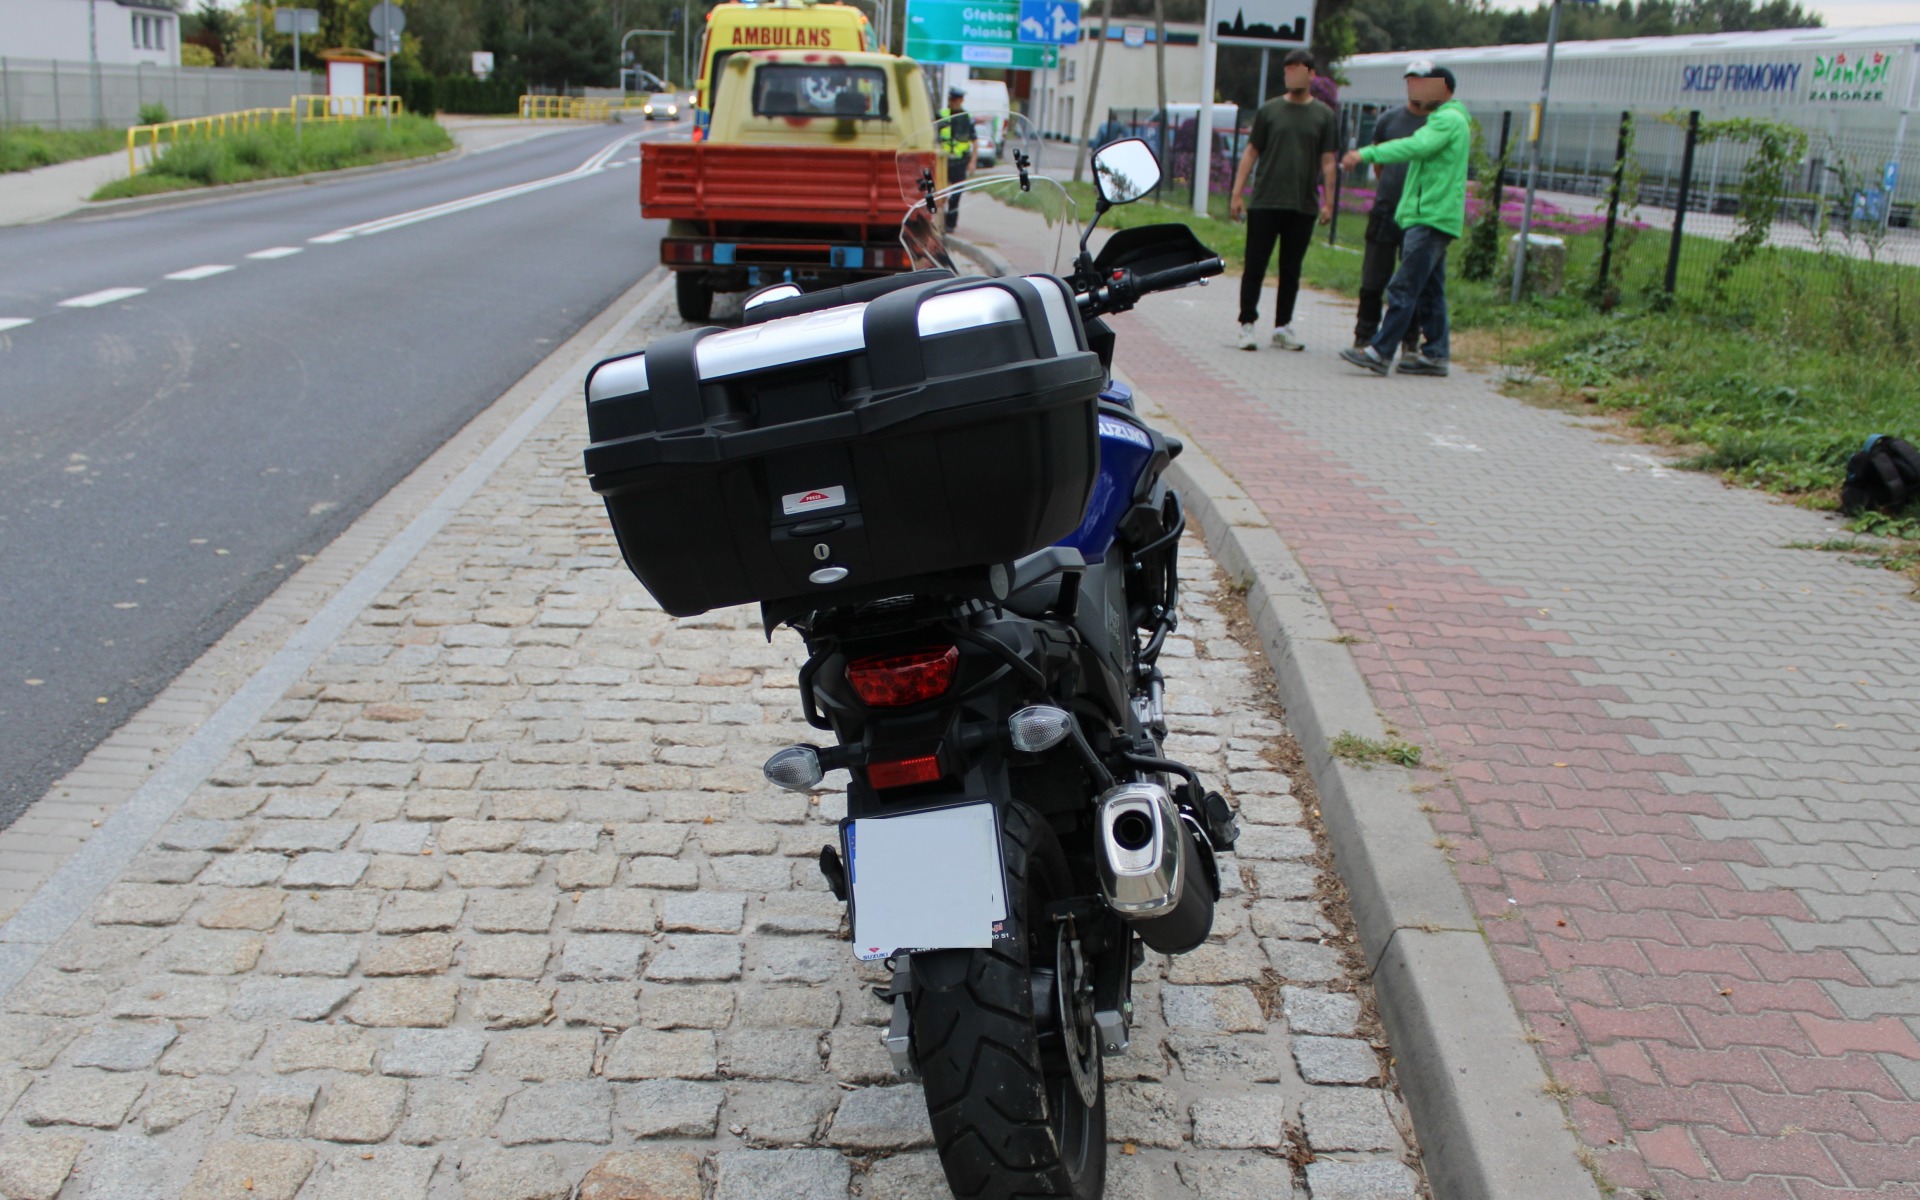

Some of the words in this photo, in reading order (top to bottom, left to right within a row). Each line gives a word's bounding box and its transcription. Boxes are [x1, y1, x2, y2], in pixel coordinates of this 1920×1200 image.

[962, 7, 1019, 23] Głębowi
[732, 27, 831, 47] AMBULANS
[962, 24, 1013, 39] Polanka
[1681, 64, 1723, 92] SKLEP
[1724, 62, 1802, 92] FIRMOWY
[1808, 90, 1884, 101] ZABORZE
[863, 952, 889, 960] SUZUKI
